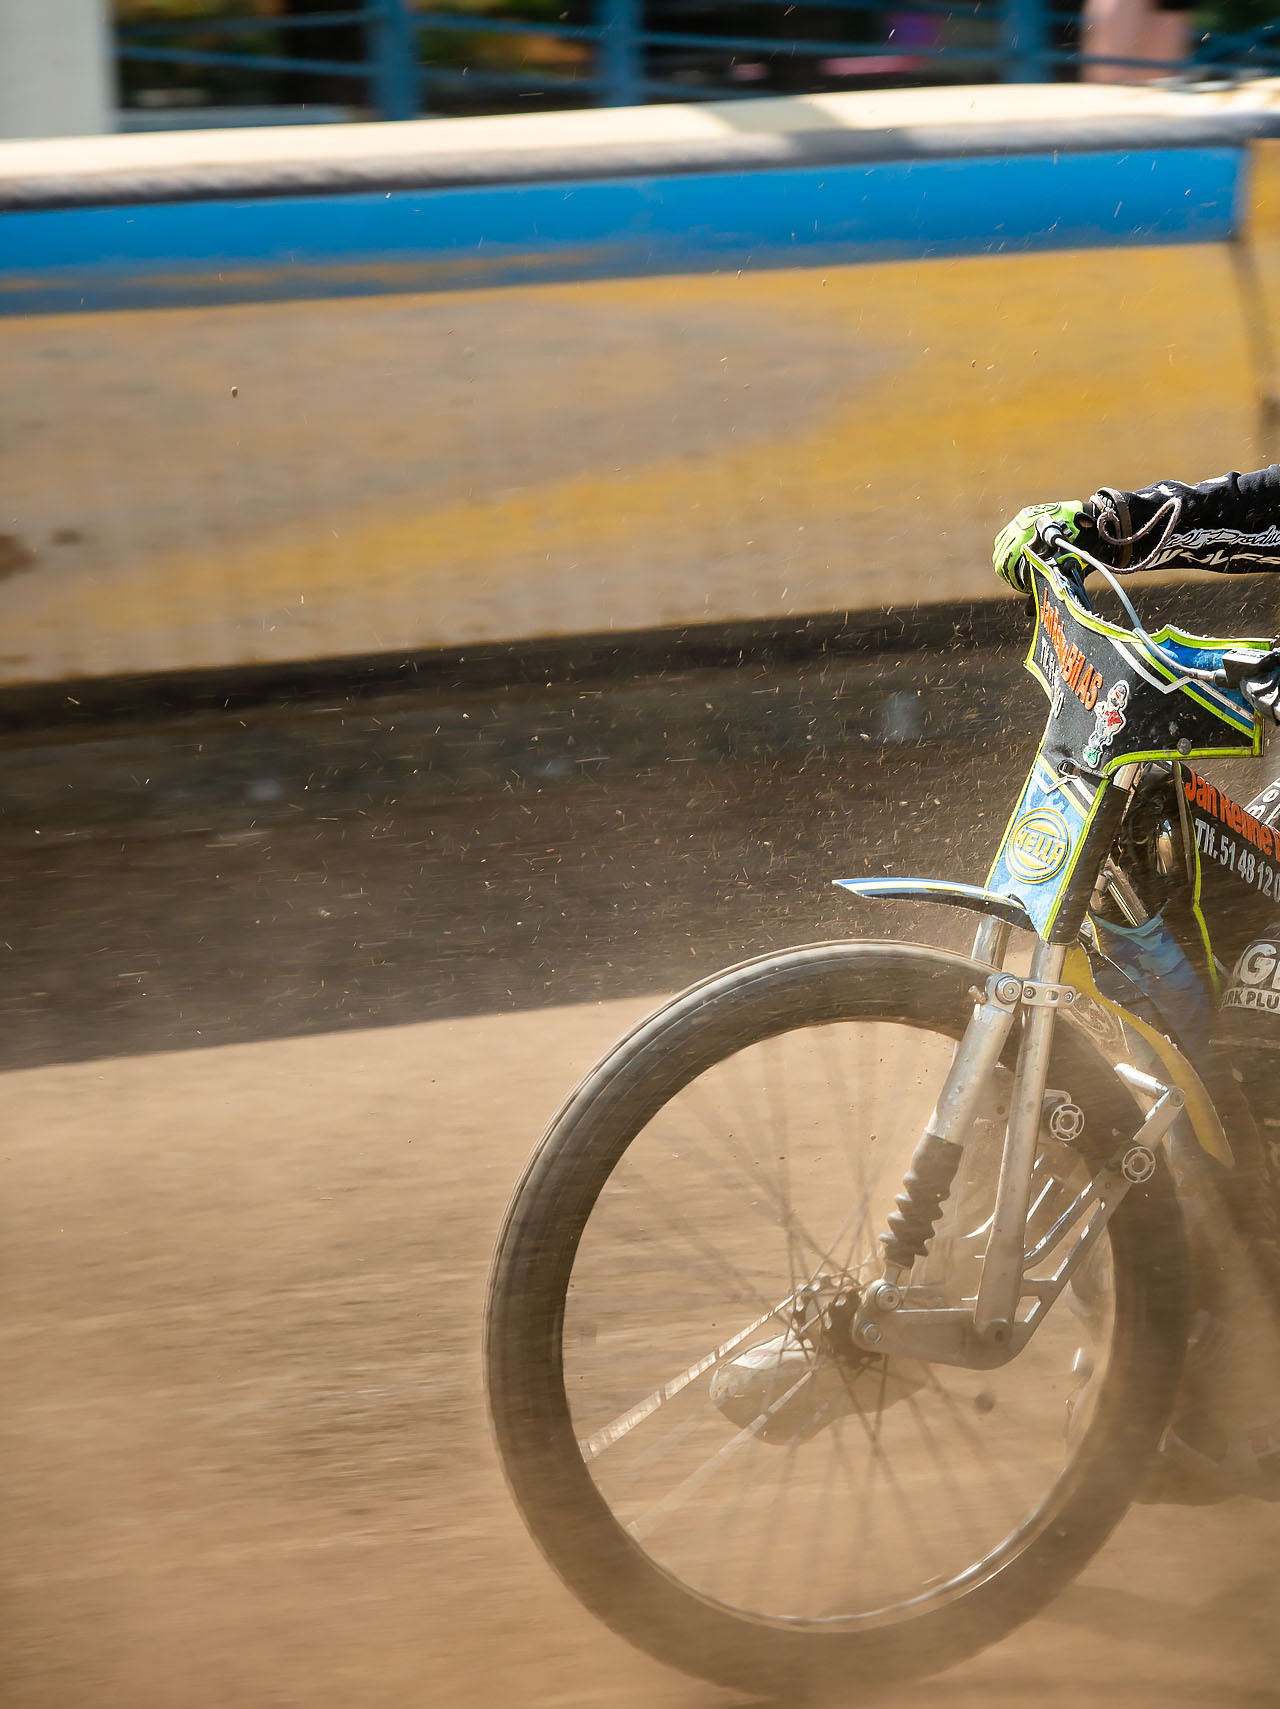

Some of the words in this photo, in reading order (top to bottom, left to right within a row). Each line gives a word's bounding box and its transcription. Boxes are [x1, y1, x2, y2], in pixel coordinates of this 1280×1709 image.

[1185, 765, 1217, 817] Jan
[1014, 828, 1067, 867] HELLA
[1219, 834, 1236, 871] 51
[1237, 848, 1256, 884] 48
[1257, 861, 1273, 897] 12
